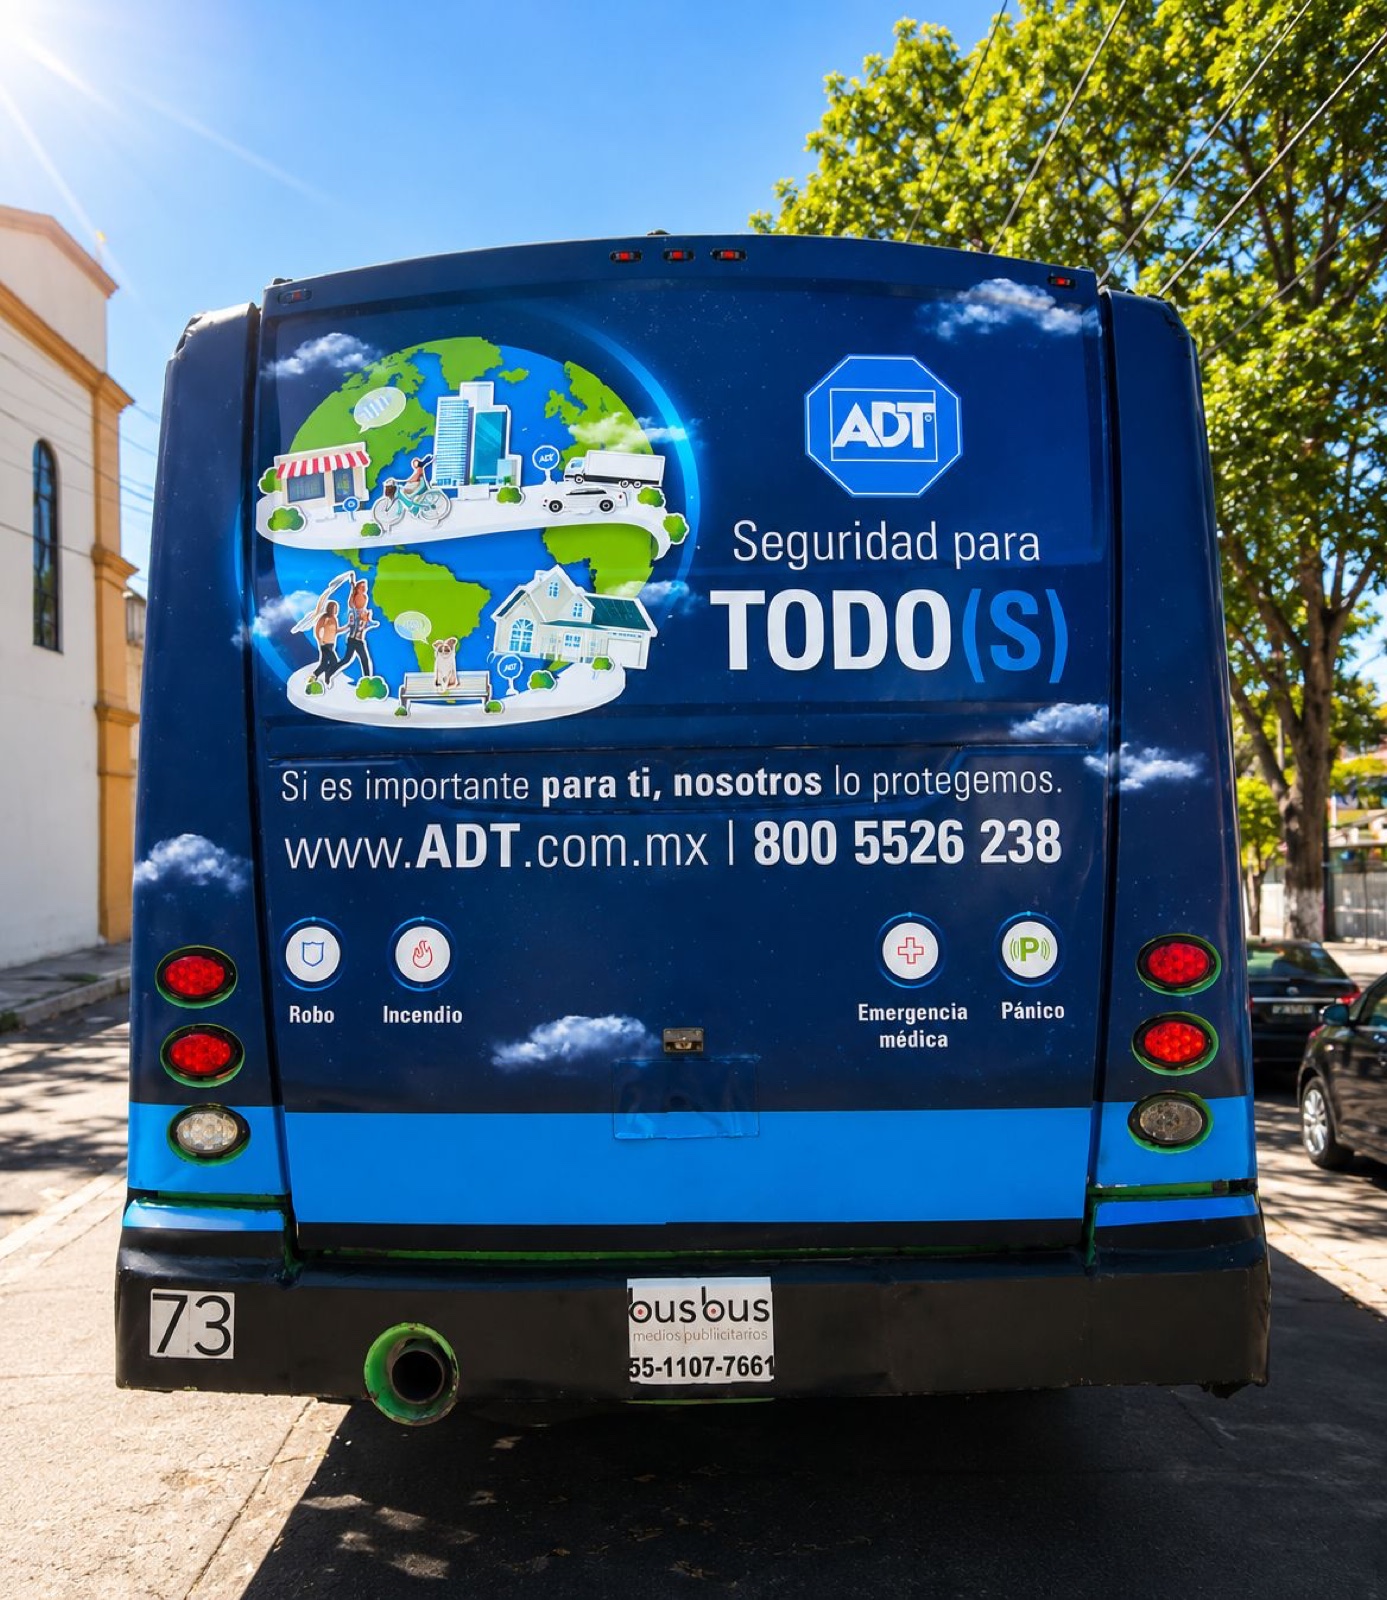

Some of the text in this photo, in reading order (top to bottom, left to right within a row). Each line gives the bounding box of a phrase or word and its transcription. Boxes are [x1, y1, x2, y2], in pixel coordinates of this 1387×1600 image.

[832, 401, 936, 449] ADT
[733, 519, 1041, 570] Seguridad para
[281, 764, 1063, 808] Si es importante para ti, nosotros lo protegemos.
[284, 817, 1063, 870] www.ADT.com.mx 800 5526 238
[289, 1004, 335, 1024] Robo
[382, 1005, 463, 1024] Incendio
[858, 1002, 968, 1026] Emergencia
[1001, 1000, 1065, 1020] Pánico
[879, 1028, 949, 1049] médica
[628, 1286, 770, 1323] busbus
[152, 1293, 231, 1356] 73
[633, 1329, 681, 1342] medios
[630, 1355, 774, 1378] 55-1107-7661
